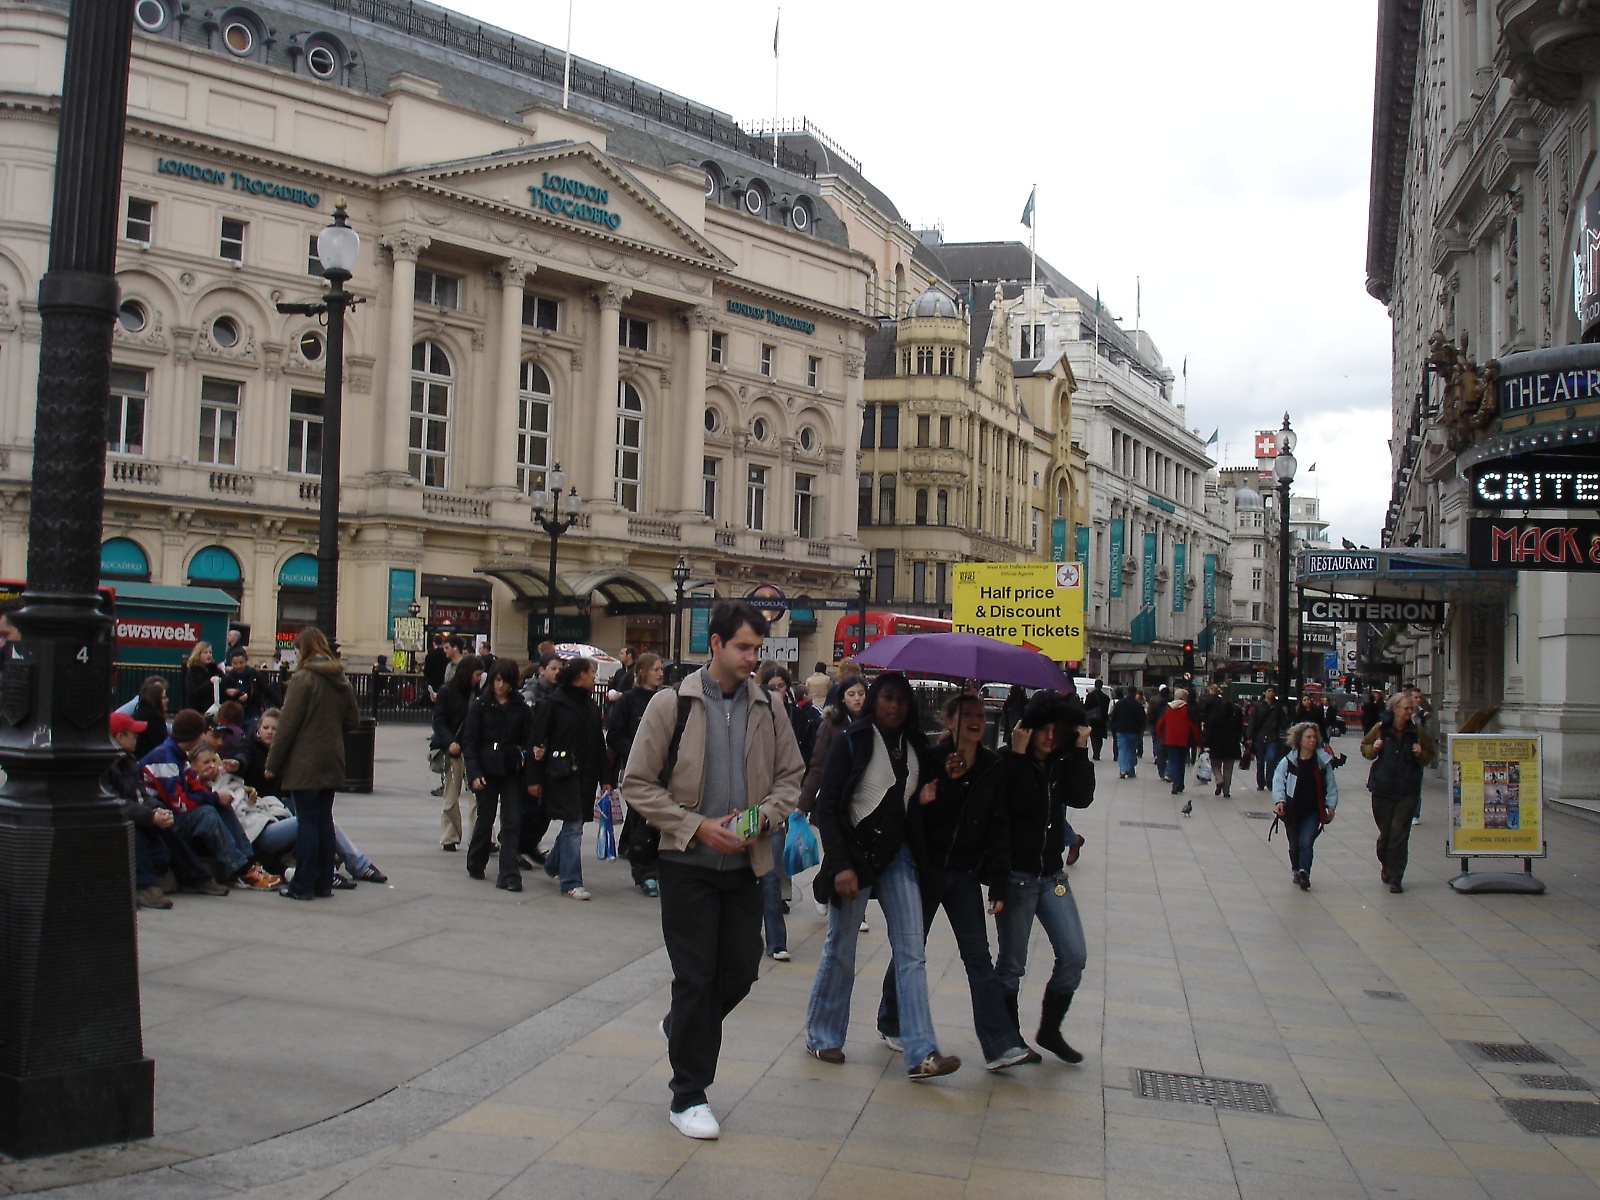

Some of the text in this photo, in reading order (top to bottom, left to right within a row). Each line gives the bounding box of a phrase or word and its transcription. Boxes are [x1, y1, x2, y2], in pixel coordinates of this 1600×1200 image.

[157, 157, 321, 208] LONDON TROCADERO
[542, 171, 609, 204] LONDON
[528, 185, 621, 230] TROCADERO
[727, 300, 816, 335] LONDON TROCADERO
[1505, 369, 1600, 409] THEATR
[1478, 472, 1599, 500] CRITE
[1491, 525, 1584, 563] MACK
[101, 560, 142, 571] ROCADERO
[1111, 541, 1120, 593] TROCADERO
[1143, 554, 1153, 604] TROCADERO
[1311, 557, 1375, 572] RESTAURANT
[980, 586, 1054, 602] Half price
[976, 605, 1061, 618] & Discount
[1312, 602, 1436, 620] CRITERION
[955, 623, 1080, 637] Theatre Tickets
[76, 646, 89, 664] 4
